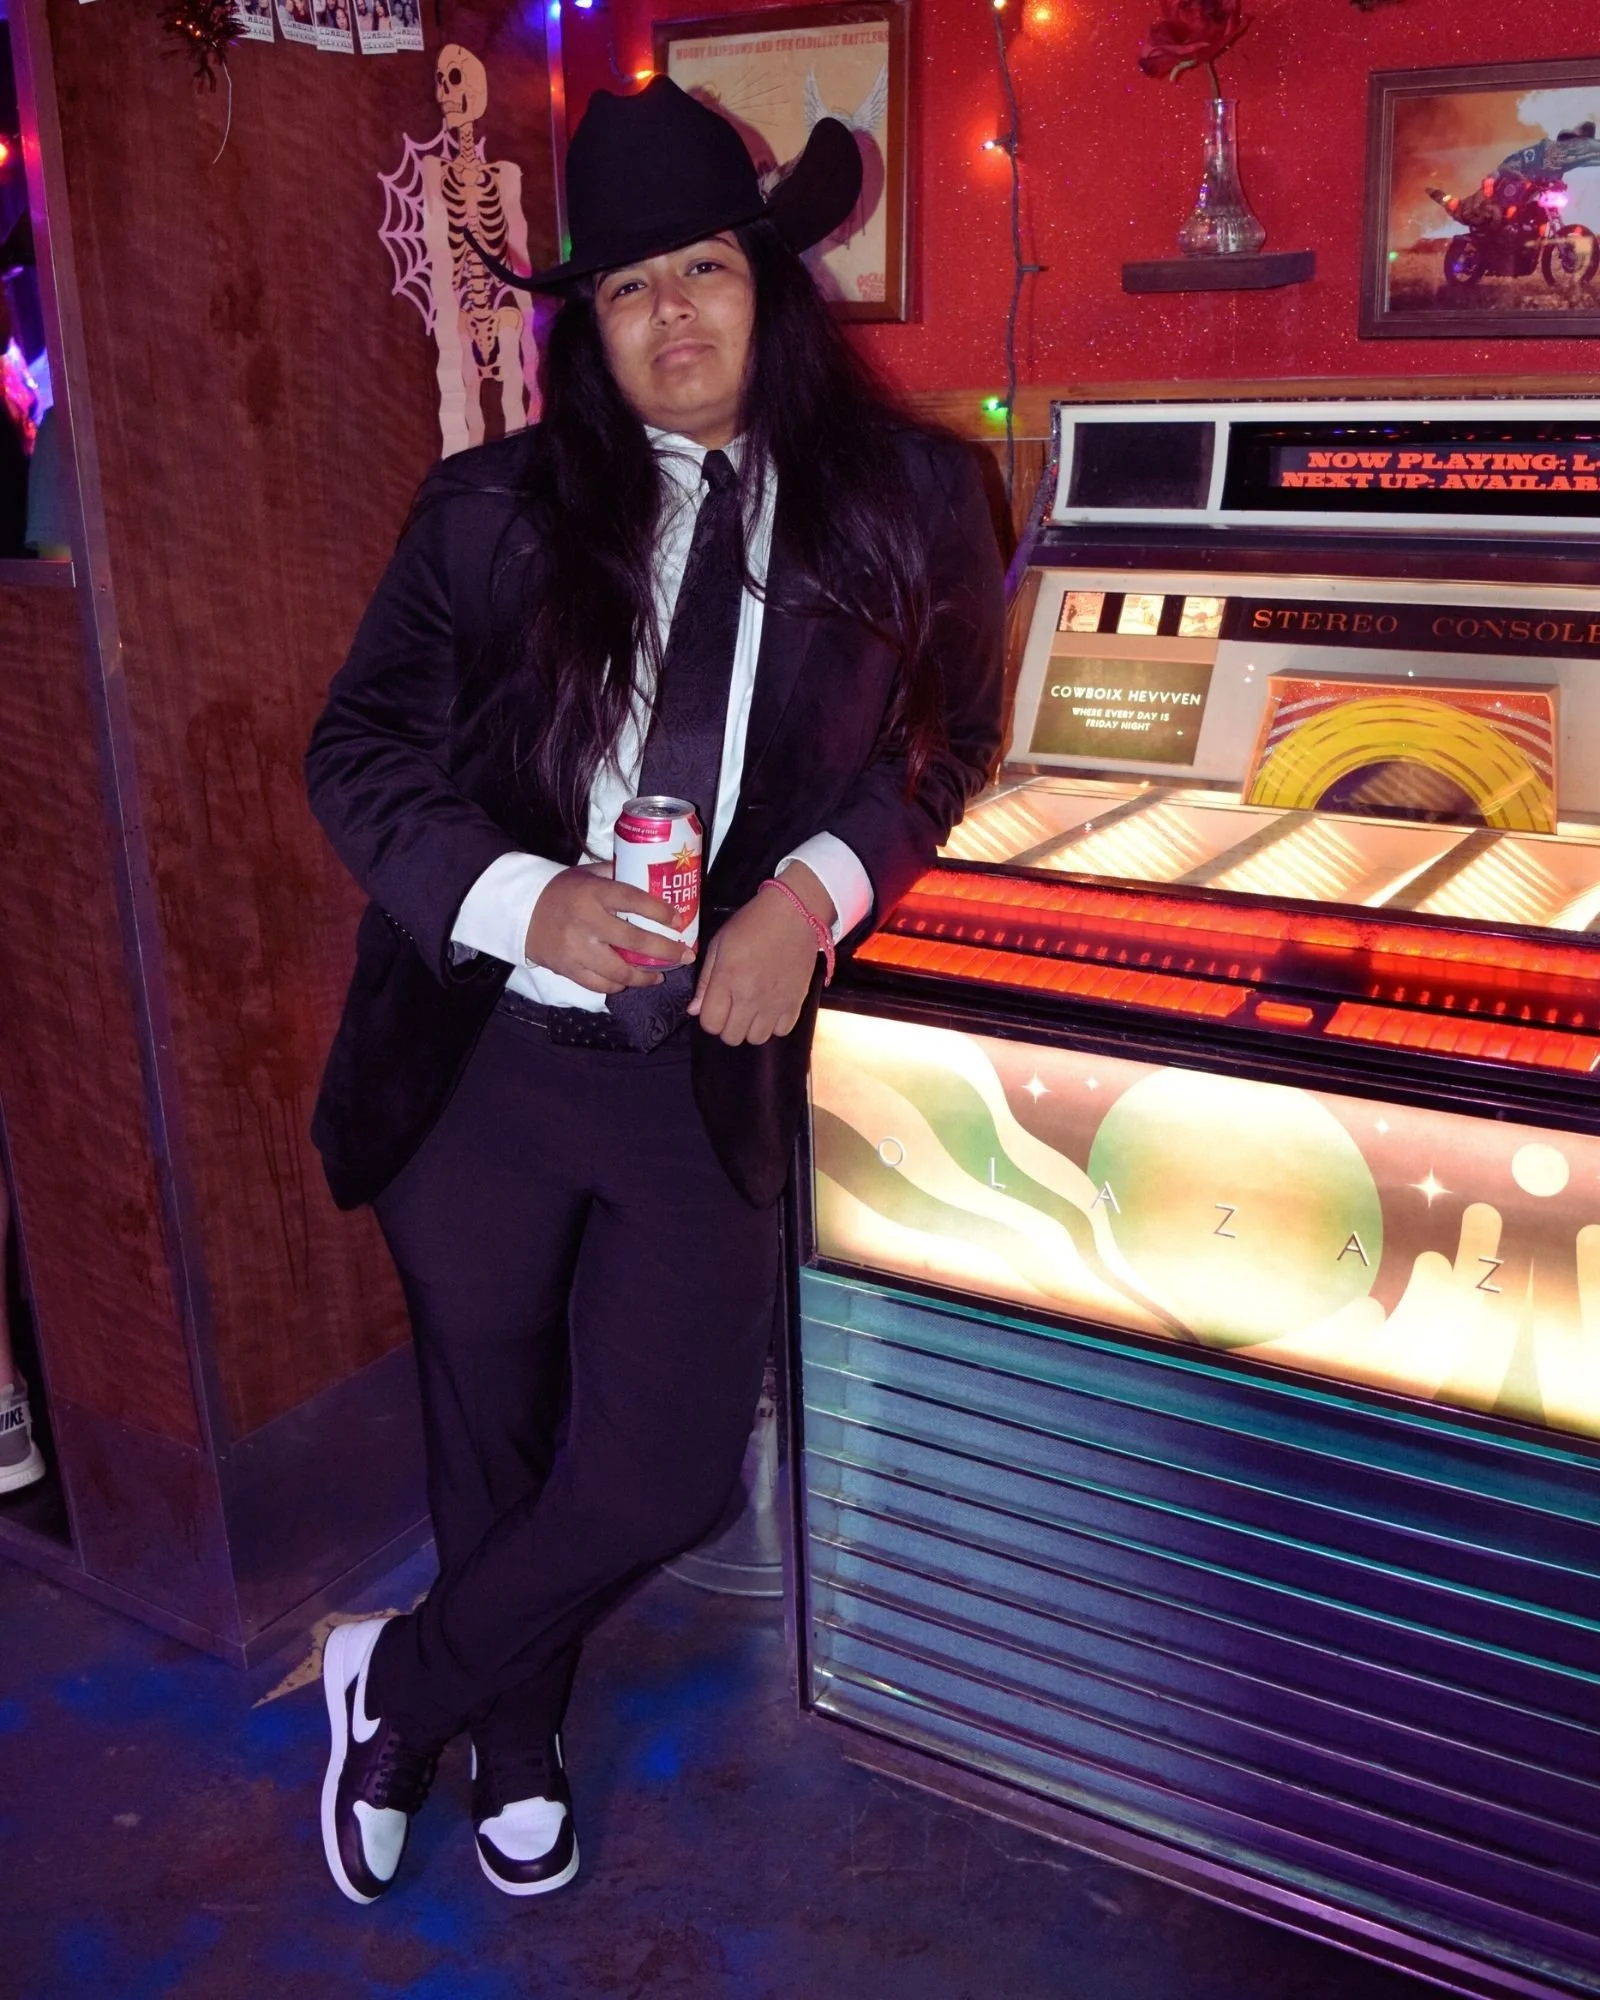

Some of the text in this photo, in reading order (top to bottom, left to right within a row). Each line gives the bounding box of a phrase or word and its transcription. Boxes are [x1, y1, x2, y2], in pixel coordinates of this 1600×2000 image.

[755, 40, 774, 54] AND
[1308, 452, 1392, 468] NOW
[1398, 453, 1567, 471] PLAYING:
[1282, 472, 1600, 491] NEXT UP: AVAILAB
[1252, 608, 1398, 634] STEREO
[1051, 685, 1201, 705] COWBOIX HEVVVEN
[1072, 707, 1170, 722] WHERE EVERY DAY IS
[1085, 719, 1151, 731] FRIDAY NIGHT
[662, 869, 698, 889] LONE
[662, 884, 698, 904] STAR
